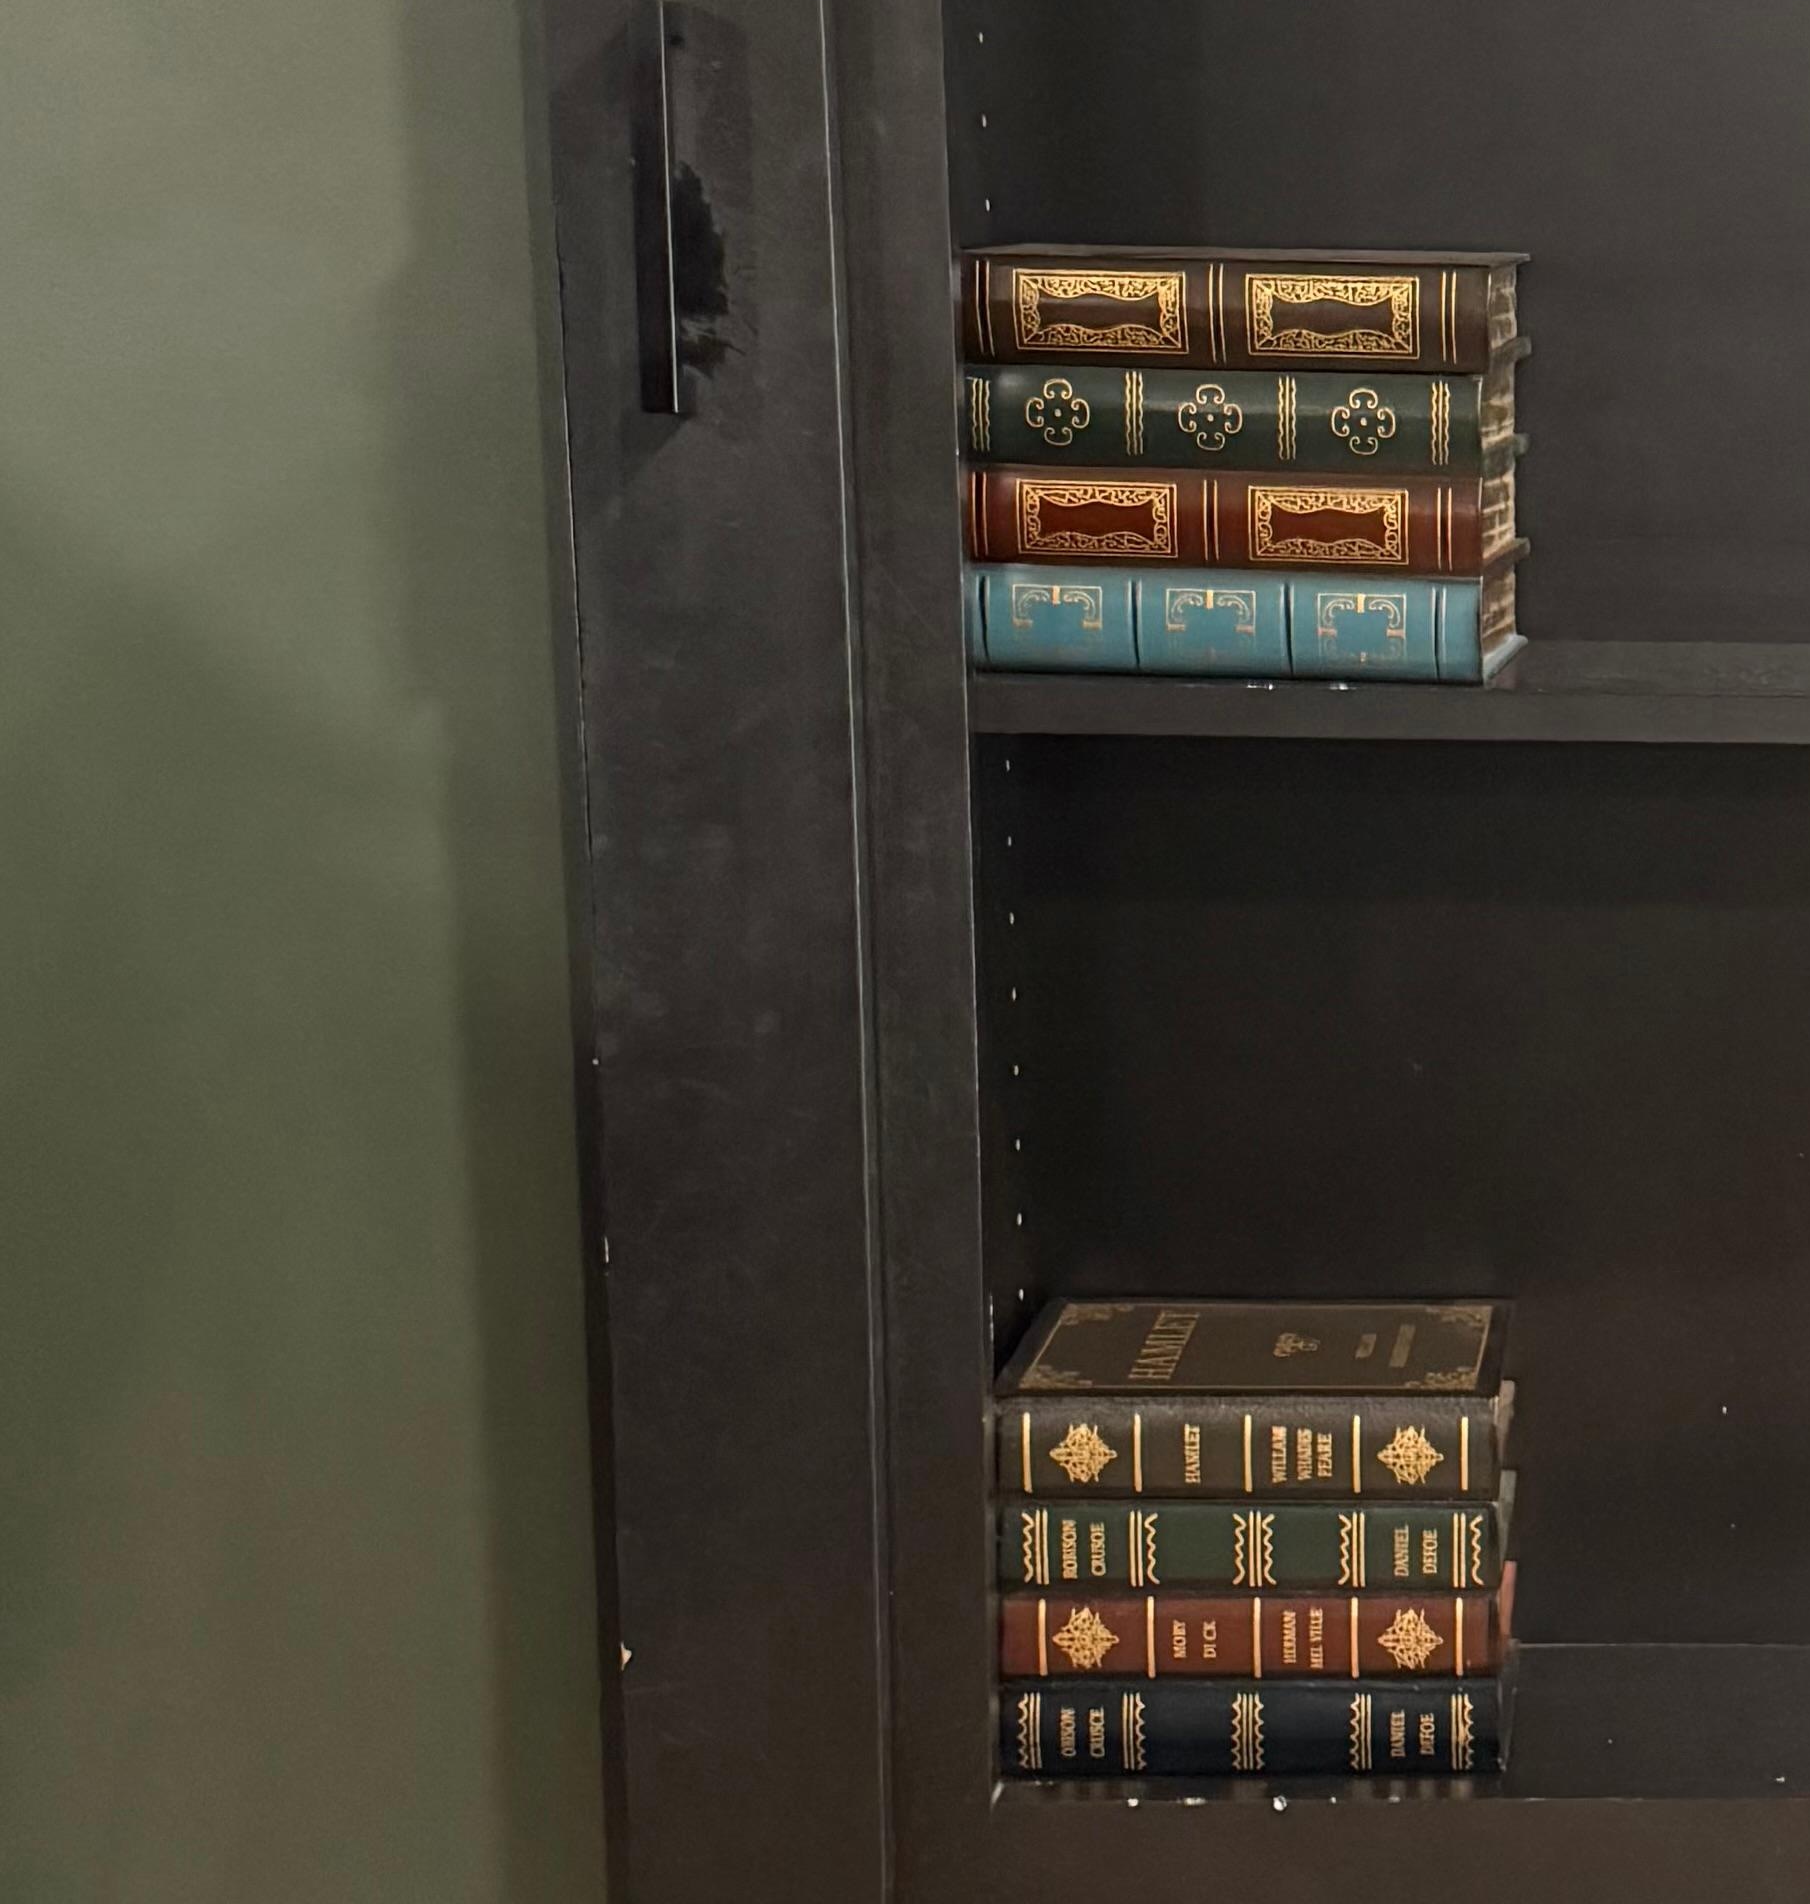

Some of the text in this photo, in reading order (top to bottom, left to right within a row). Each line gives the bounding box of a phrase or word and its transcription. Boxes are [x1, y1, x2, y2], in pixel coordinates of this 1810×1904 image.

[1128, 1310, 1199, 1380] HAMLET
[1183, 1423, 1202, 1484] HAMLET
[1393, 1524, 1411, 1578] DANIEL
[1422, 1529, 1439, 1574] DEFOE
[1171, 1619, 1188, 1659] MOBY
